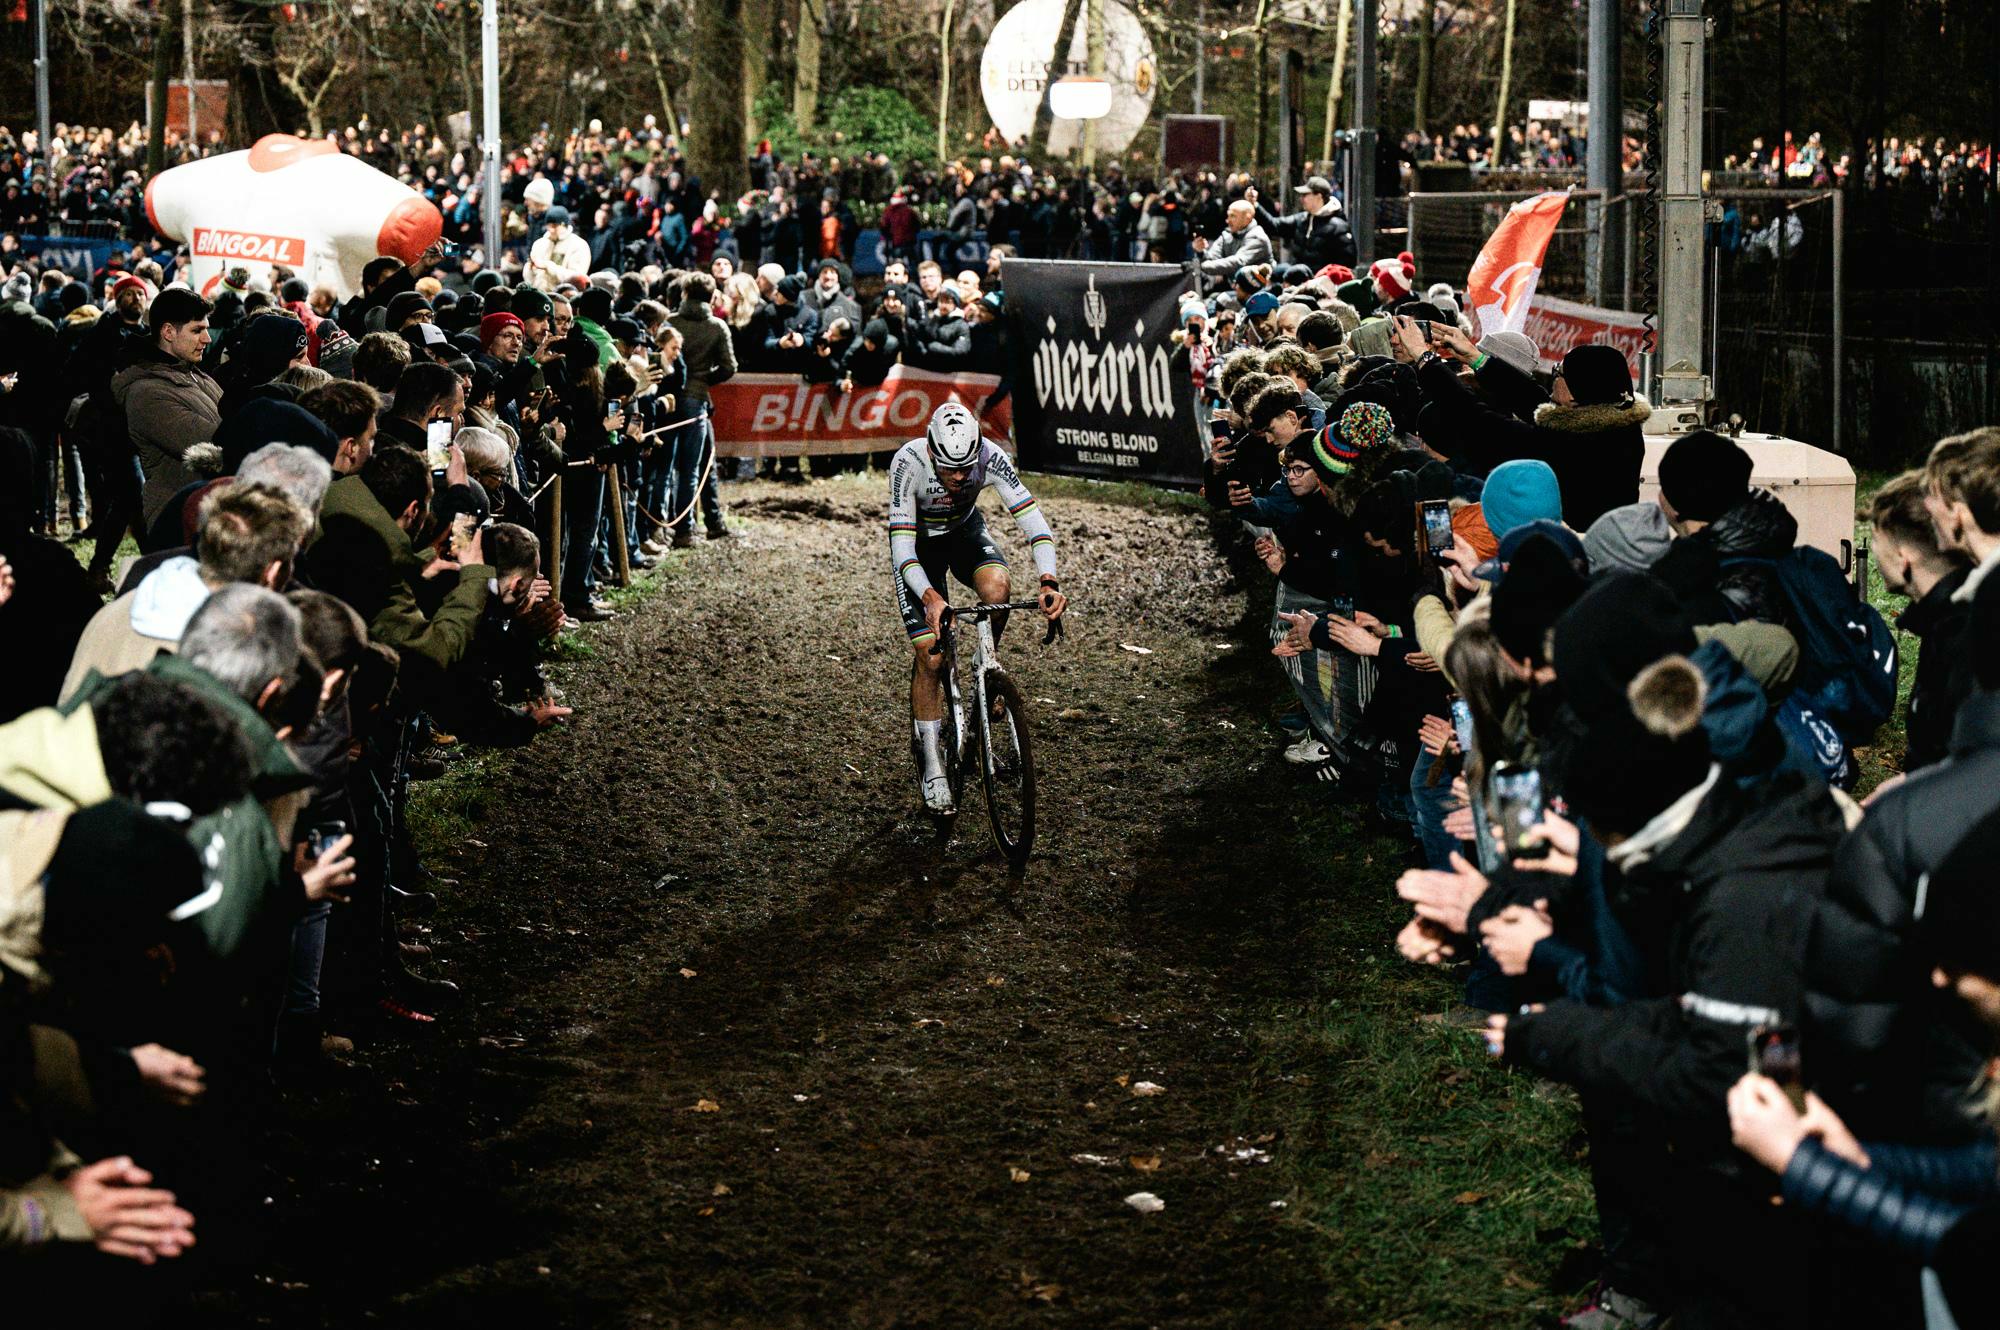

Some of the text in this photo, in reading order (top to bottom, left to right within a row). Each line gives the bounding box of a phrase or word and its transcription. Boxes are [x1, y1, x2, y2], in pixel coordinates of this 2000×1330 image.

[1056, 428, 1158, 453] STRONG BLOND
[986, 452, 1020, 488] Alpecin
[1077, 450, 1140, 467] BELGIAN BEER
[892, 457, 906, 508] deceuninck
